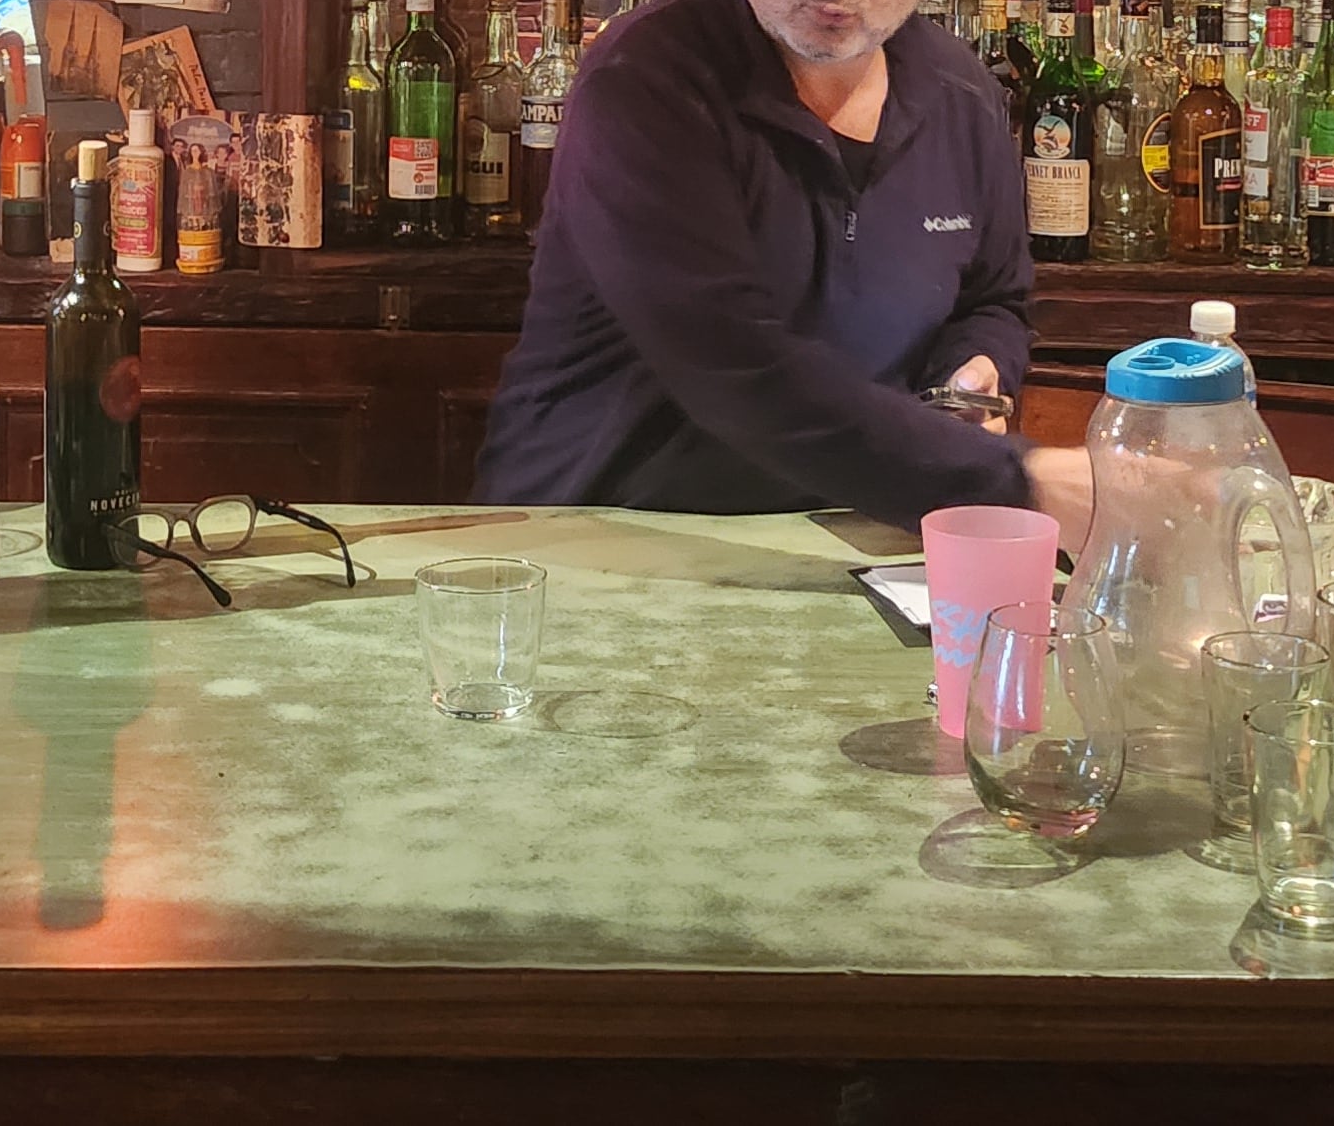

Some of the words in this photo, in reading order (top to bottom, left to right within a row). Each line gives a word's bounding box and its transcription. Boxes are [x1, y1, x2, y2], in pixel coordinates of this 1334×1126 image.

[520, 104, 564, 122] AMPAR
[1052, 165, 1081, 179] BRANCA
[1214, 157, 1242, 179] PREM
